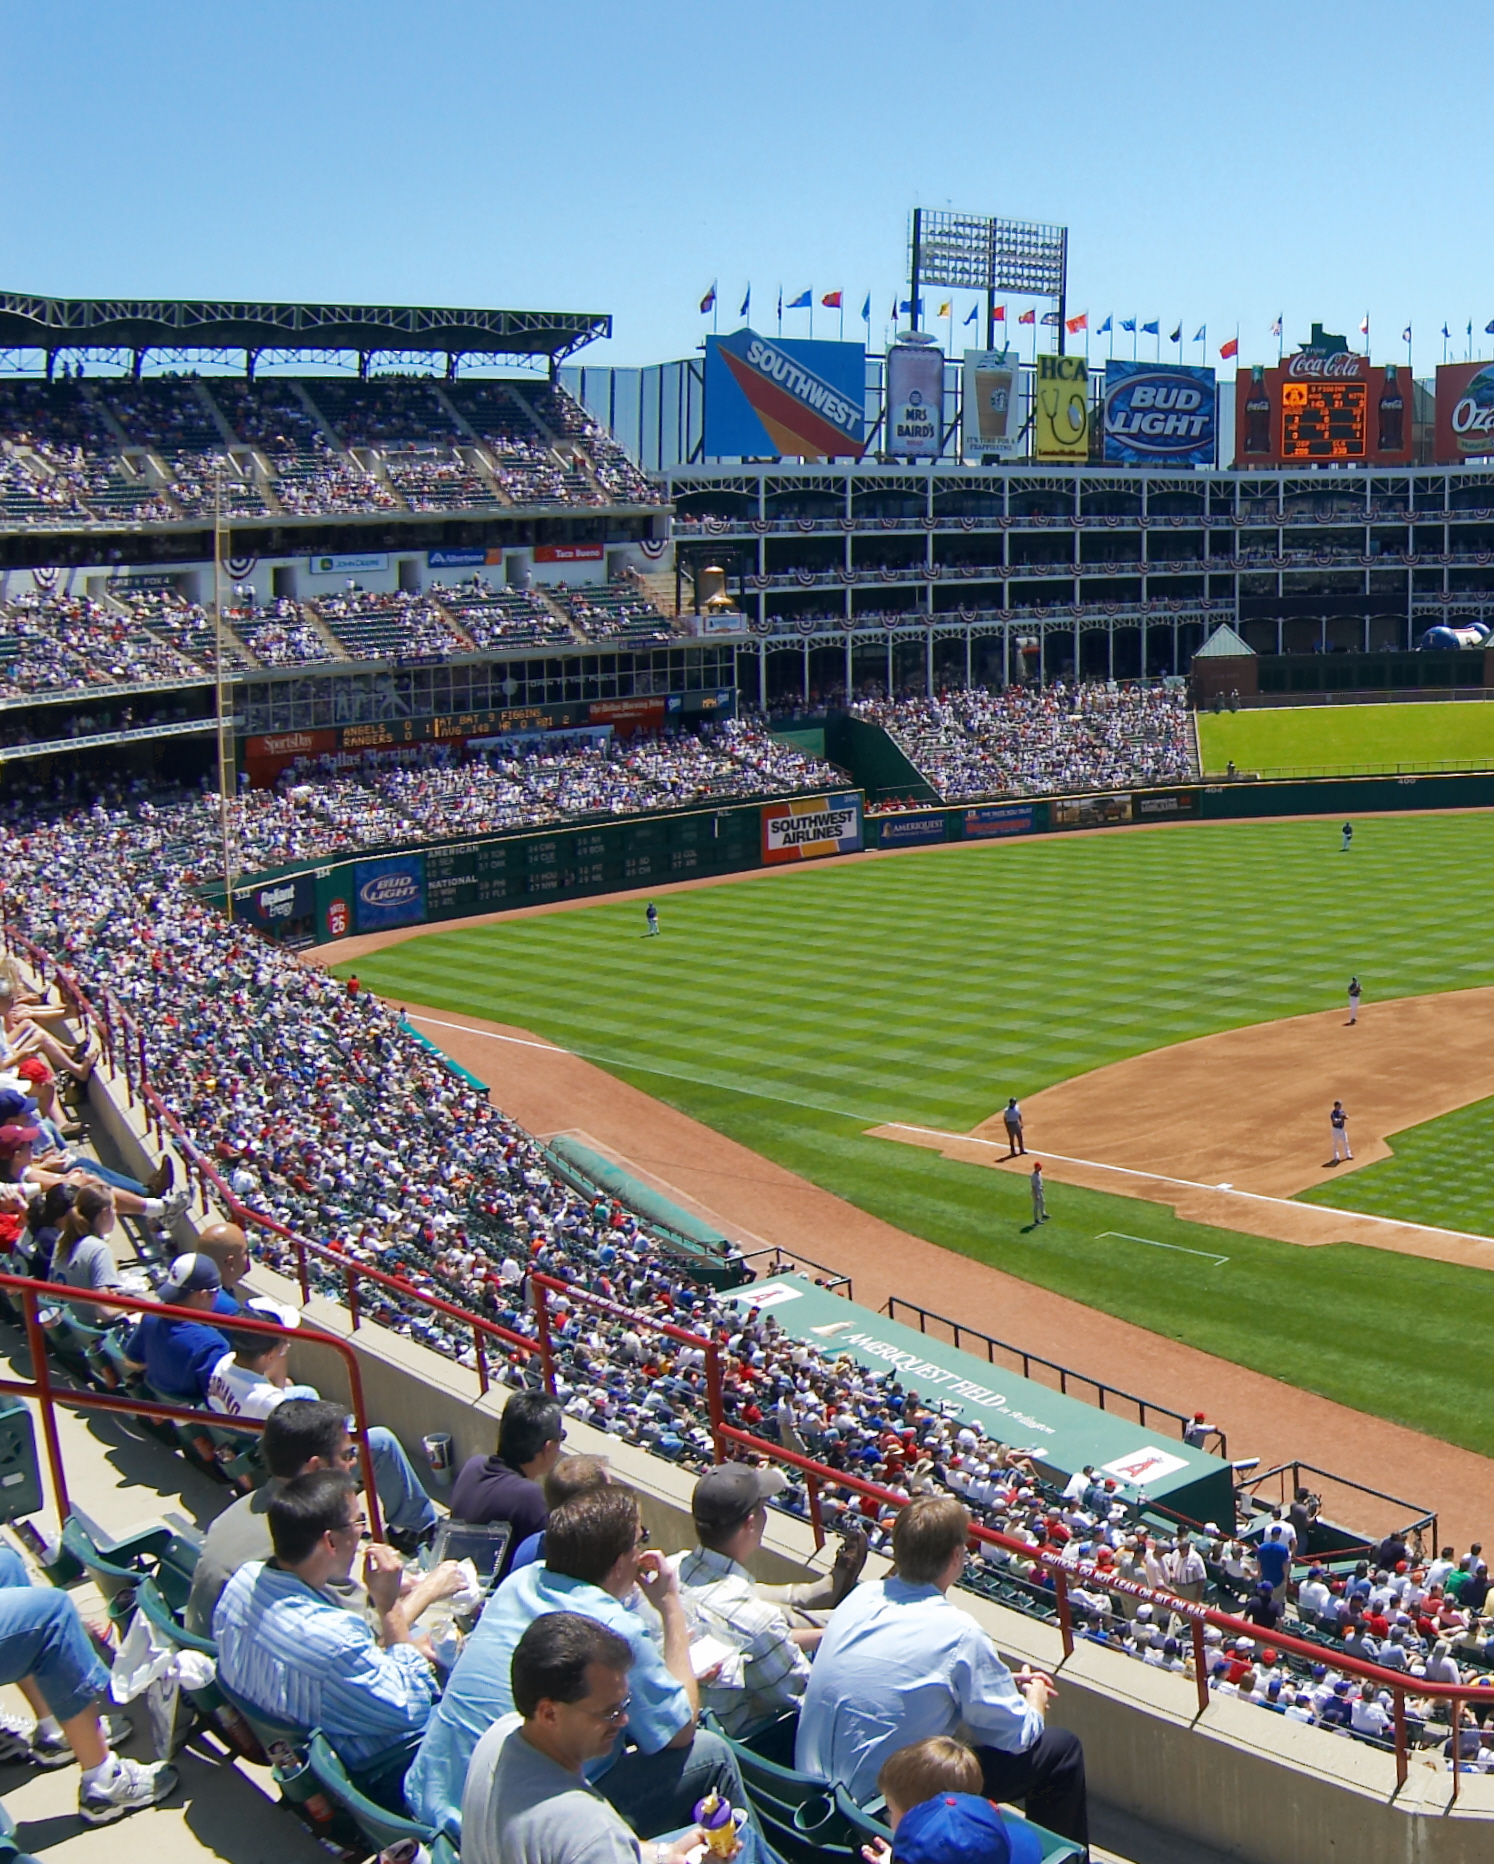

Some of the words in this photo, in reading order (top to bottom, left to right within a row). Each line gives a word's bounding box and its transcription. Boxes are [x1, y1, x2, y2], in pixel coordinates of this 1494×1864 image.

[1306, 347, 1328, 355] Enjoy
[1039, 357, 1089, 382] HCA
[1289, 352, 1360, 377] Coca-Cola
[747, 341, 861, 431] SOUTHWEST
[1130, 386, 1202, 411] BUD
[905, 408, 928, 422] MRS
[897, 423, 935, 439] BAIRD'S
[1110, 411, 1210, 437] LIGHT
[555, 549, 574, 559] Taco
[576, 549, 600, 558] Bueno
[440, 716, 453, 726] AT
[459, 714, 480, 725] BAT
[488, 712, 496, 722] 9
[501, 708, 542, 720] FIGGINS
[499, 721, 511, 730] HR
[520, 719, 527, 729] 0
[563, 715, 570, 725] 2
[343, 723, 386, 737] ANGELS
[404, 720, 412, 730] 0
[264, 733, 314, 754] SportsDay
[343, 733, 393, 747] RANGERS
[404, 731, 412, 740] 0
[770, 810, 854, 834] SOUTHWEST
[893, 819, 944, 831] AMERIQUEST
[782, 825, 843, 846] AIRLINES
[428, 845, 480, 858] AMERICAN
[376, 876, 412, 889] BUD
[428, 875, 479, 889] NATIONAL
[261, 884, 295, 907] Reliant
[370, 885, 419, 901] LIGHT
[269, 901, 293, 917] Energy
[332, 916, 345, 934] 26
[840, 1332, 963, 1384] AMERIQUEST
[946, 1376, 1008, 1409] FIELD
[996, 1405, 1010, 1416] in
[1008, 1410, 1056, 1435] Arlington
[1040, 1552, 1077, 1572] CAUTION:
[1079, 1566, 1093, 1577] DO
[1094, 1570, 1112, 1583] NOT
[1113, 1577, 1138, 1593] LEAN
[1138, 1586, 1153, 1598] OR
[1154, 1591, 1169, 1605] SIT
[1171, 1599, 1185, 1610] ON
[1186, 1604, 1207, 1618] RAIL
